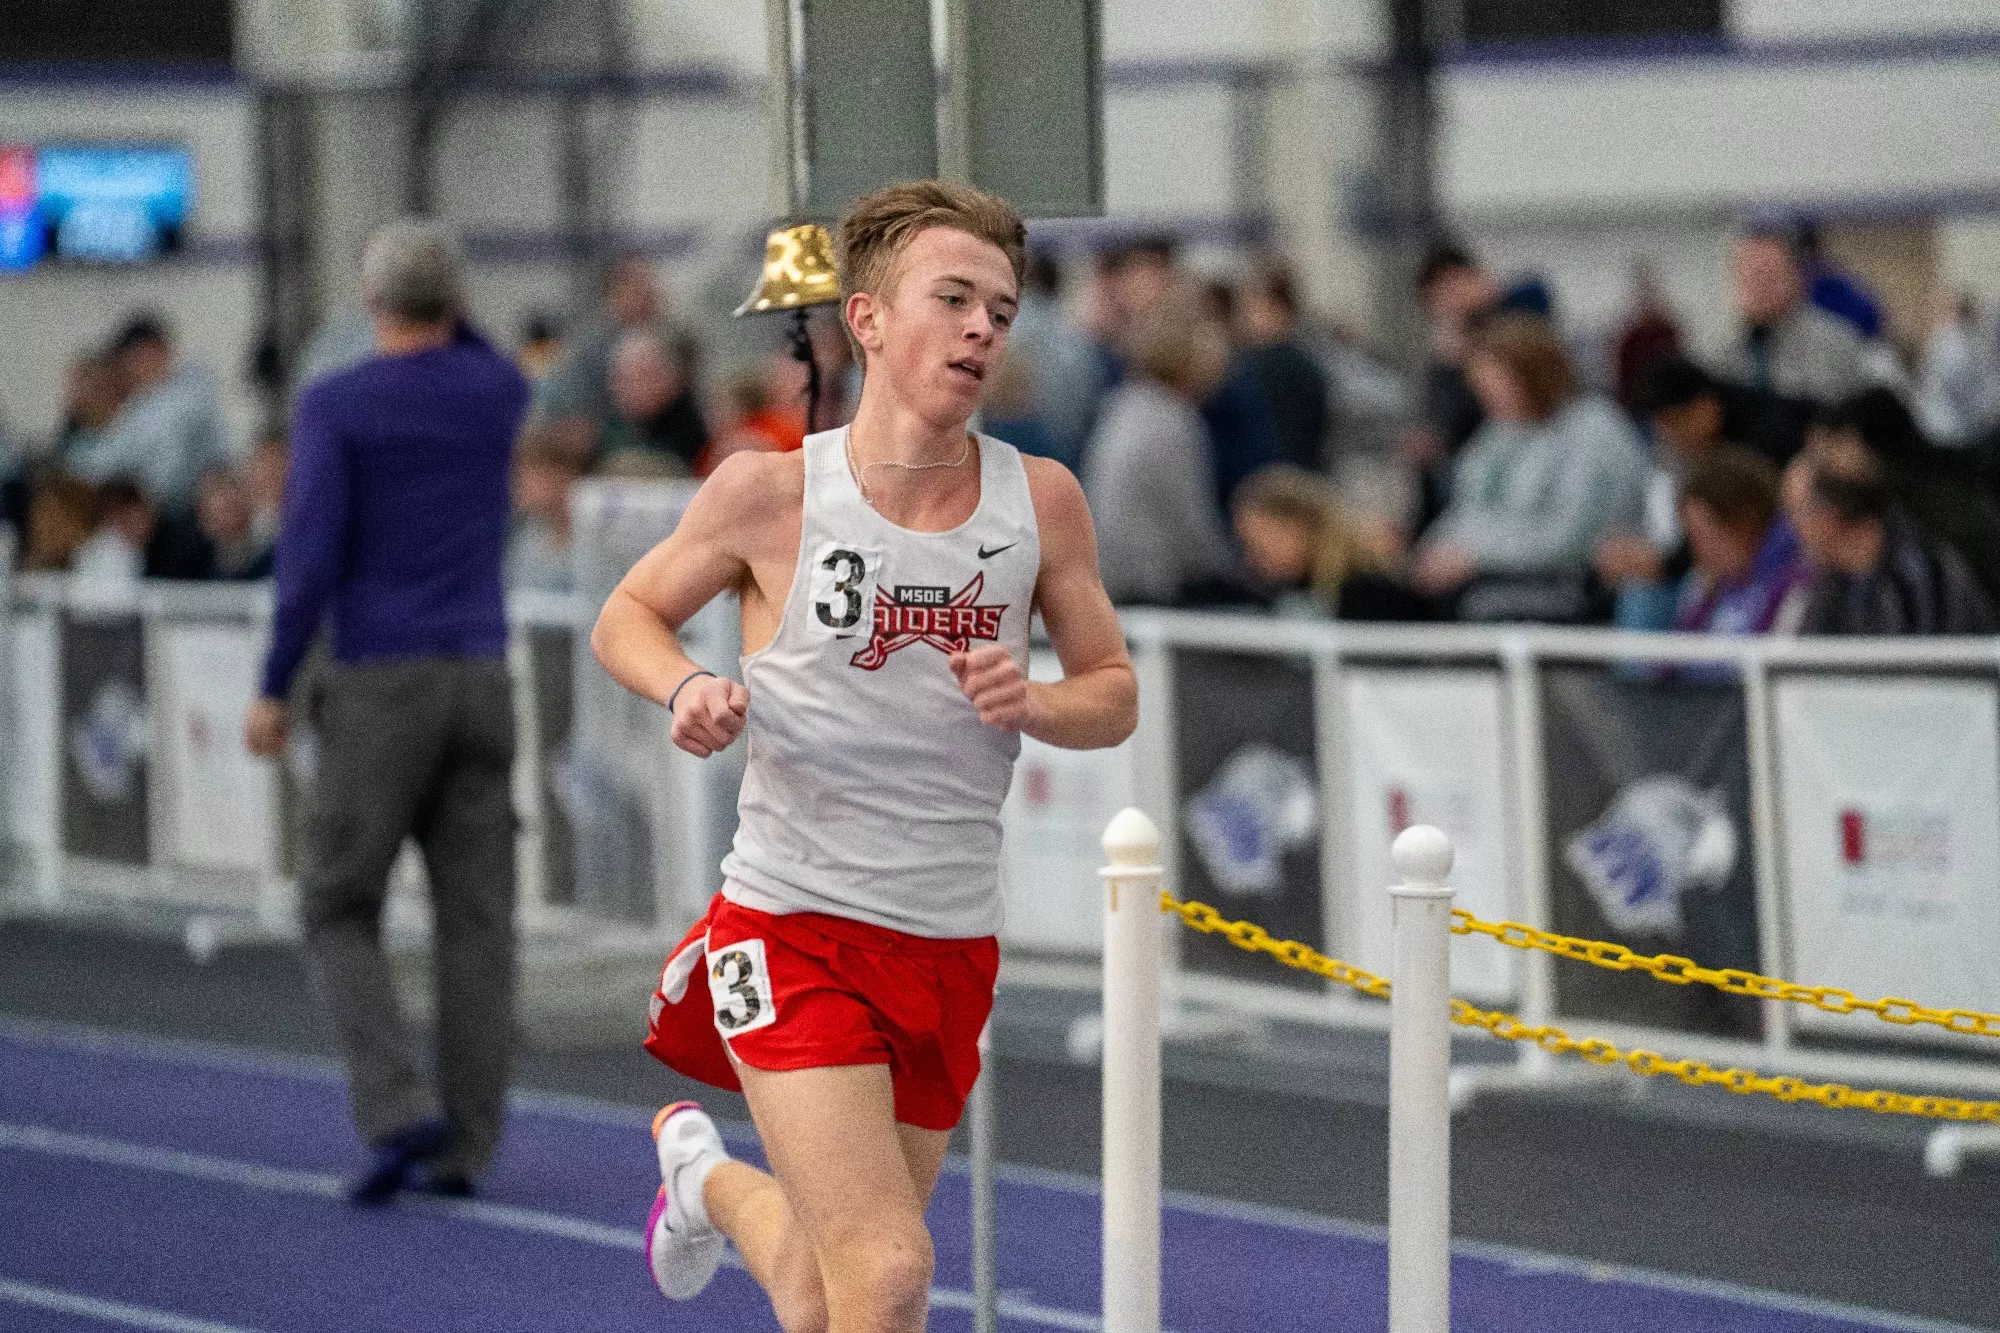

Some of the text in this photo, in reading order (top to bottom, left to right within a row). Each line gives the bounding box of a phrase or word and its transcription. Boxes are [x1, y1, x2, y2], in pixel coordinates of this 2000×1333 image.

[815, 549, 866, 629] 3
[900, 588, 945, 604] MSOE
[873, 605, 1000, 638] AIDERS
[712, 950, 761, 1029] 3
